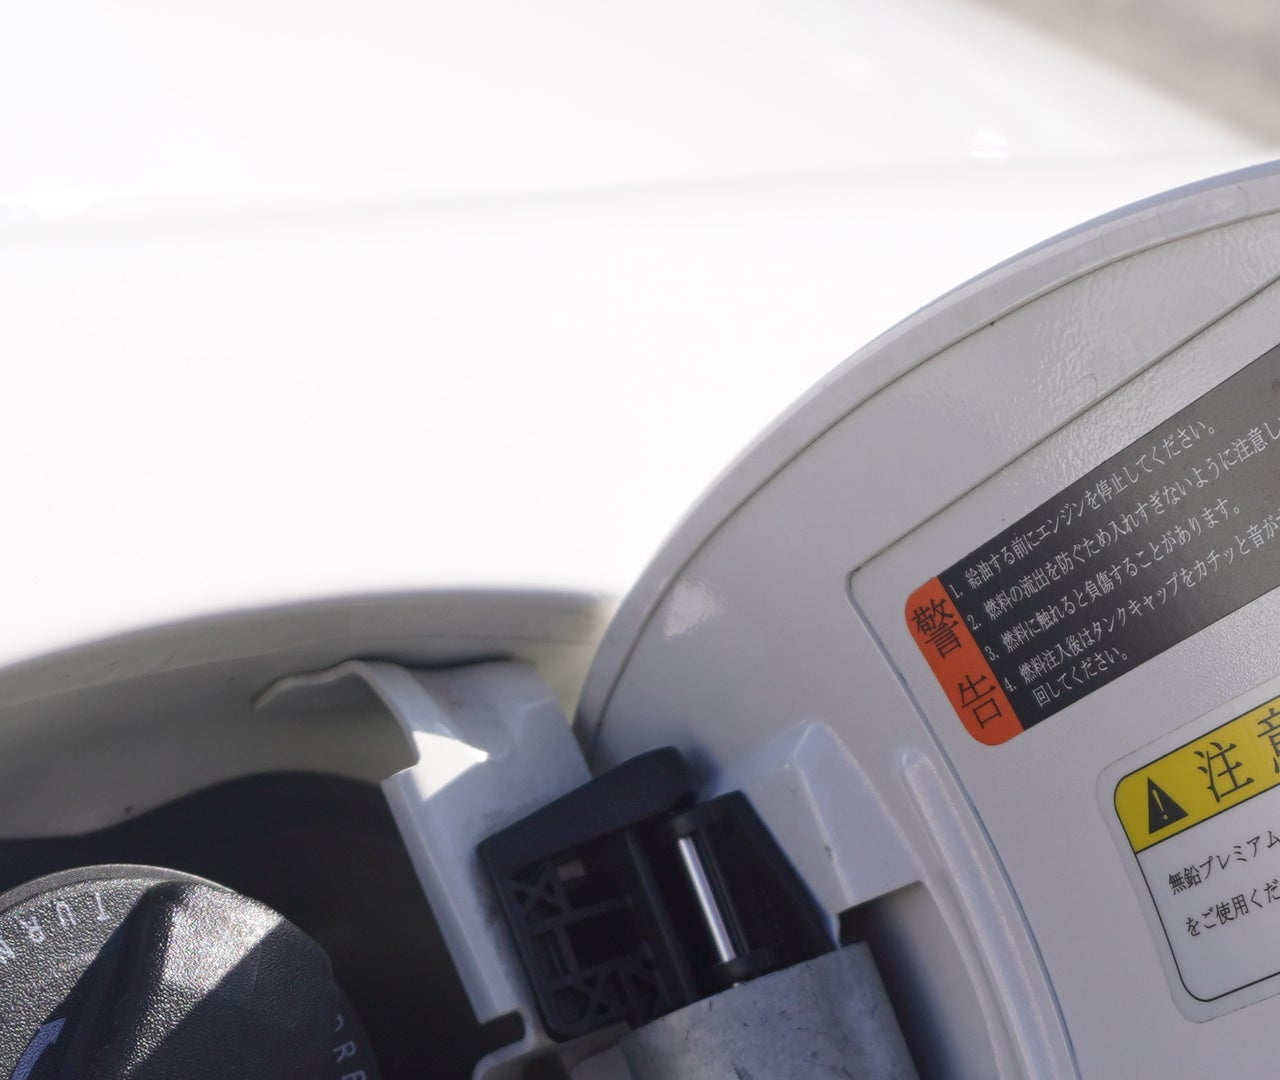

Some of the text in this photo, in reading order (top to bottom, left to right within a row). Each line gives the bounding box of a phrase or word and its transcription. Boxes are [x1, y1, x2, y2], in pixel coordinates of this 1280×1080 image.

[964, 420, 1216, 591] 給油する前にエンジンを停止してください。
[1000, 497, 1240, 654] 燃料に触れると負傷することがあります。
[911, 598, 1003, 729] 警告
[1032, 646, 1129, 708] 回してください。
